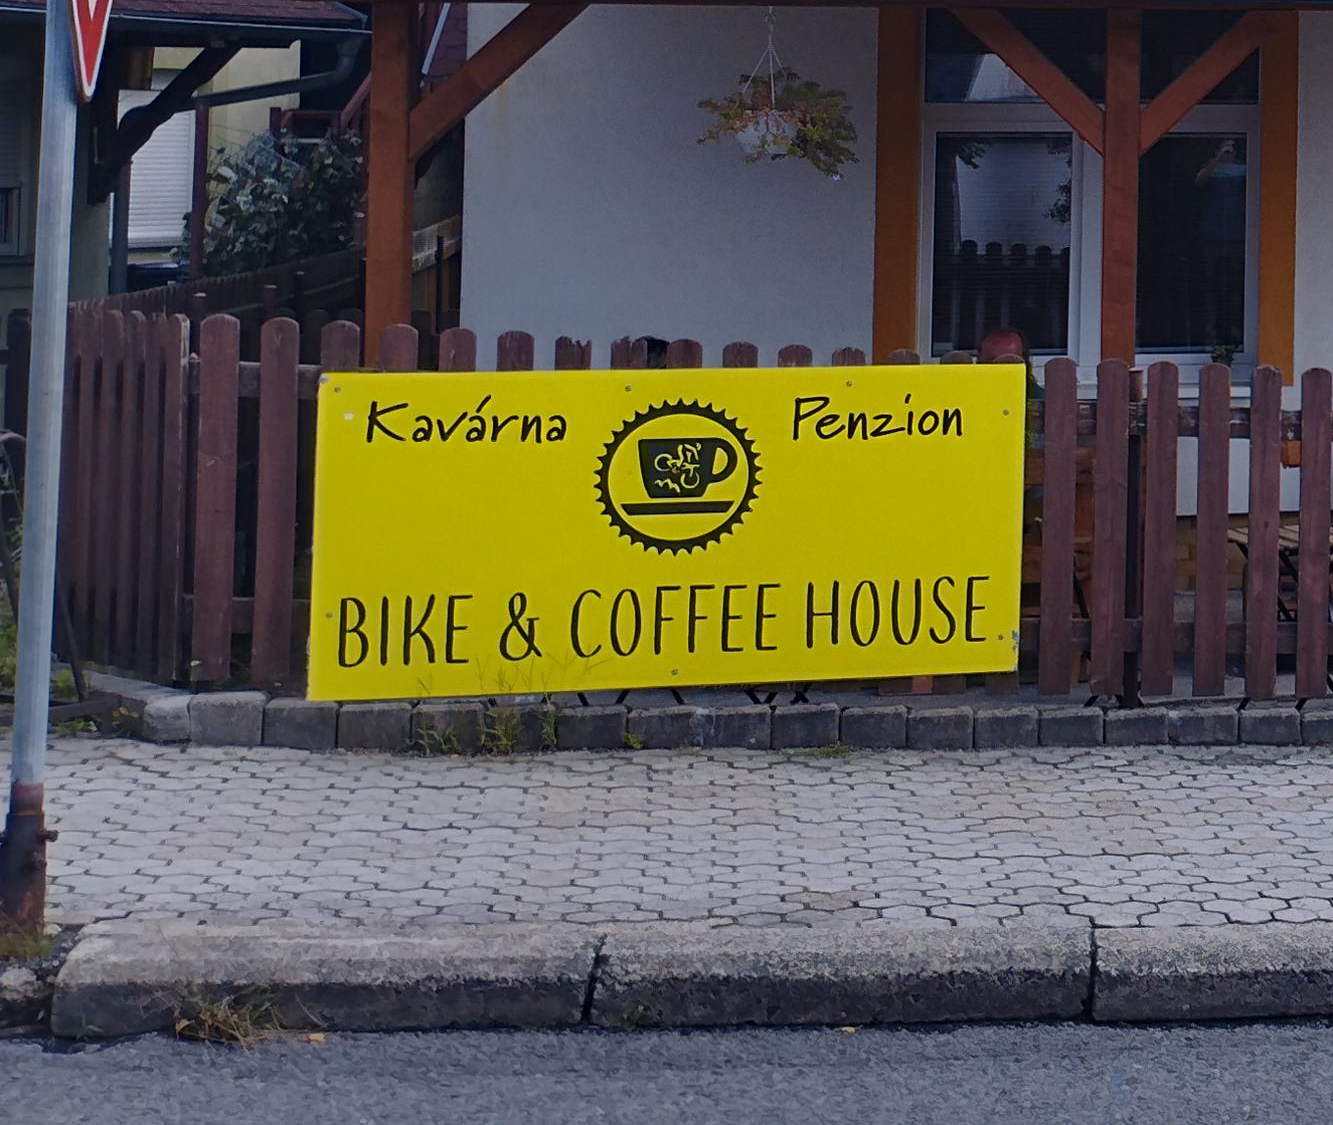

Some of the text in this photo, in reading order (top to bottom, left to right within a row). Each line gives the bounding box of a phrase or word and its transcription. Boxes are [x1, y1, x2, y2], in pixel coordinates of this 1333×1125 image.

[366, 394, 964, 444] Kavárna Penzion
[337, 575, 991, 668] BIKE & COFFEE HOUSE
